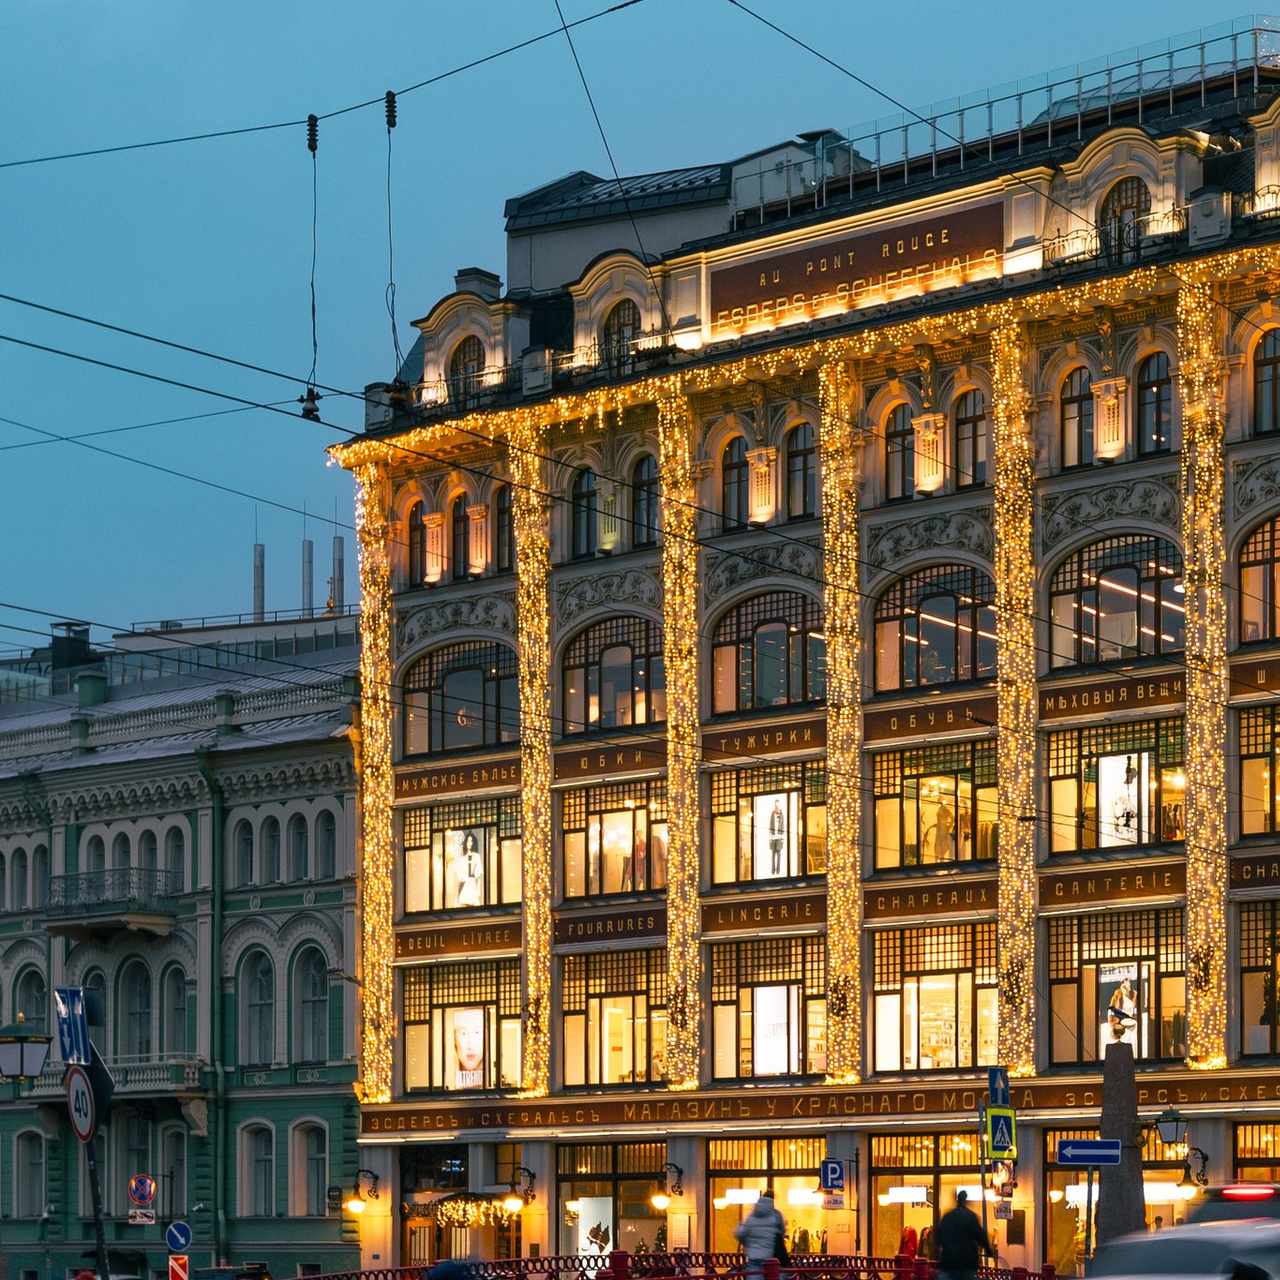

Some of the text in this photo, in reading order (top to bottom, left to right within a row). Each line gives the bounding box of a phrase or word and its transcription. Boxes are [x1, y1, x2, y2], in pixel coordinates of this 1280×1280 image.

[759, 229, 950, 287] AU PONT ROUGE
[717, 292, 806, 332] ESDERS
[1137, 681, 1182, 699] ВЕЩИ
[890, 708, 974, 730] ОБУВЬ
[720, 728, 811, 752] ТУЖУРКИ
[580, 750, 642, 770] ЮБКИ
[402, 772, 465, 791] МУЖСКОЕ
[877, 888, 987, 910] CHAPEAUX
[718, 902, 811, 923] LINGERIE
[568, 916, 655, 936] FOURRURES
[408, 929, 510, 950] DEUIL LIVREE
[75, 1089, 88, 1119] 40
[370, 1115, 459, 1130] ЭСДЕРСЪ
[481, 1109, 600, 1126] СХЕФАЛЬСЪ
[623, 1098, 751, 1120] МАГАЗИНЪ
[766, 1098, 777, 1116] У
[792, 1092, 926, 1116] КРАСНАГО
[942, 1088, 1035, 1111] МОСА
[1065, 1088, 1189, 1107] ЭСРСЪ
